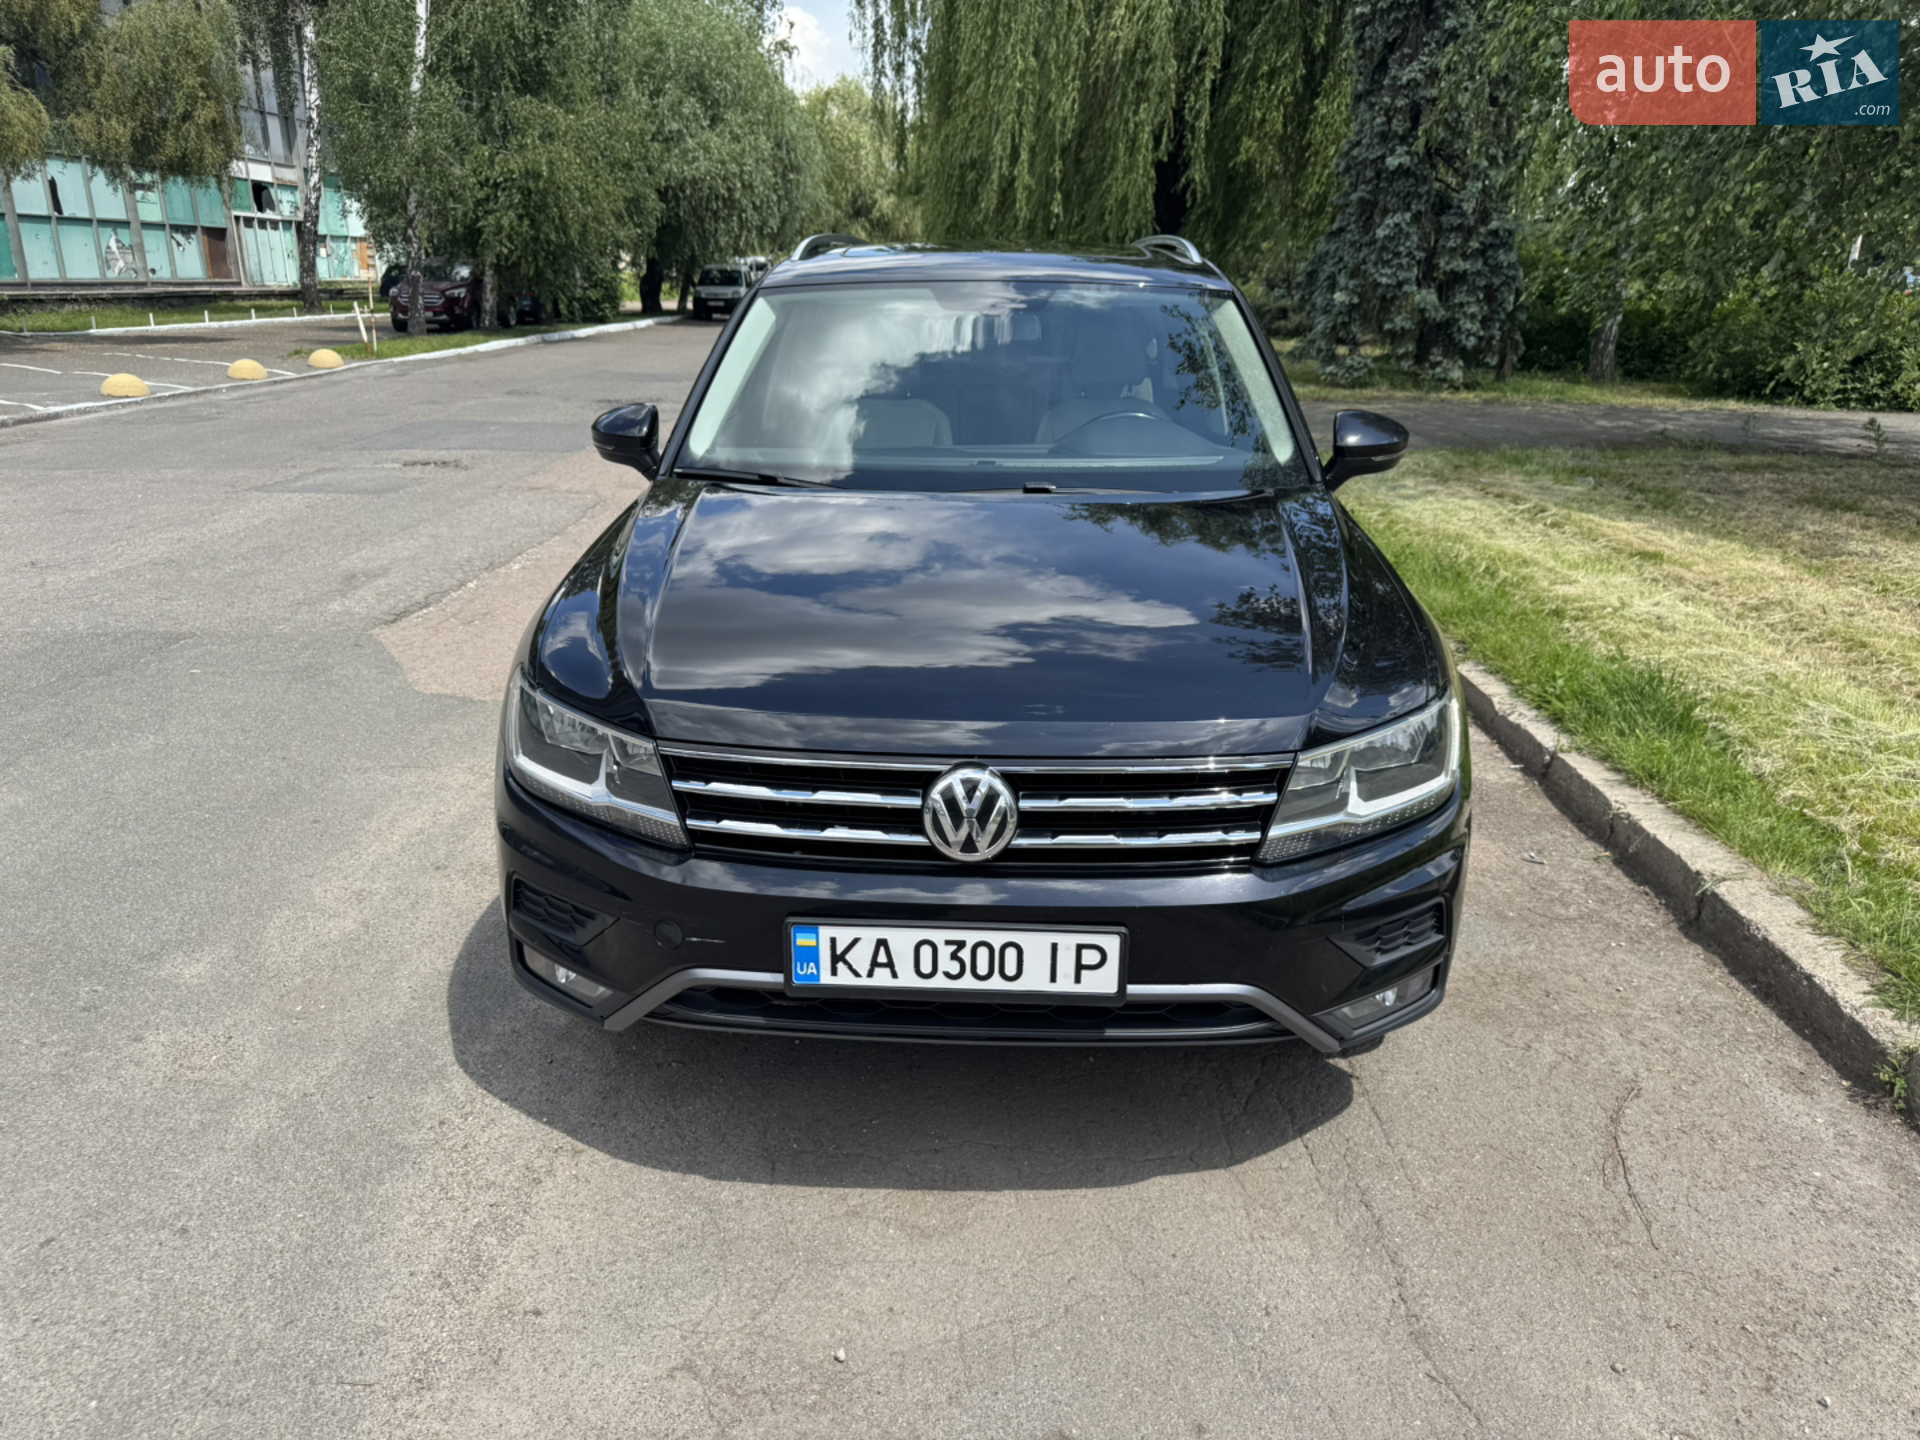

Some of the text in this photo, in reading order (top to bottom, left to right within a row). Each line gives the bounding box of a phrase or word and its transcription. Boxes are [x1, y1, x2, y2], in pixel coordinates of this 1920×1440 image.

[796, 961, 818, 976] UA
[829, 936, 1108, 984] KA 0300 IP
